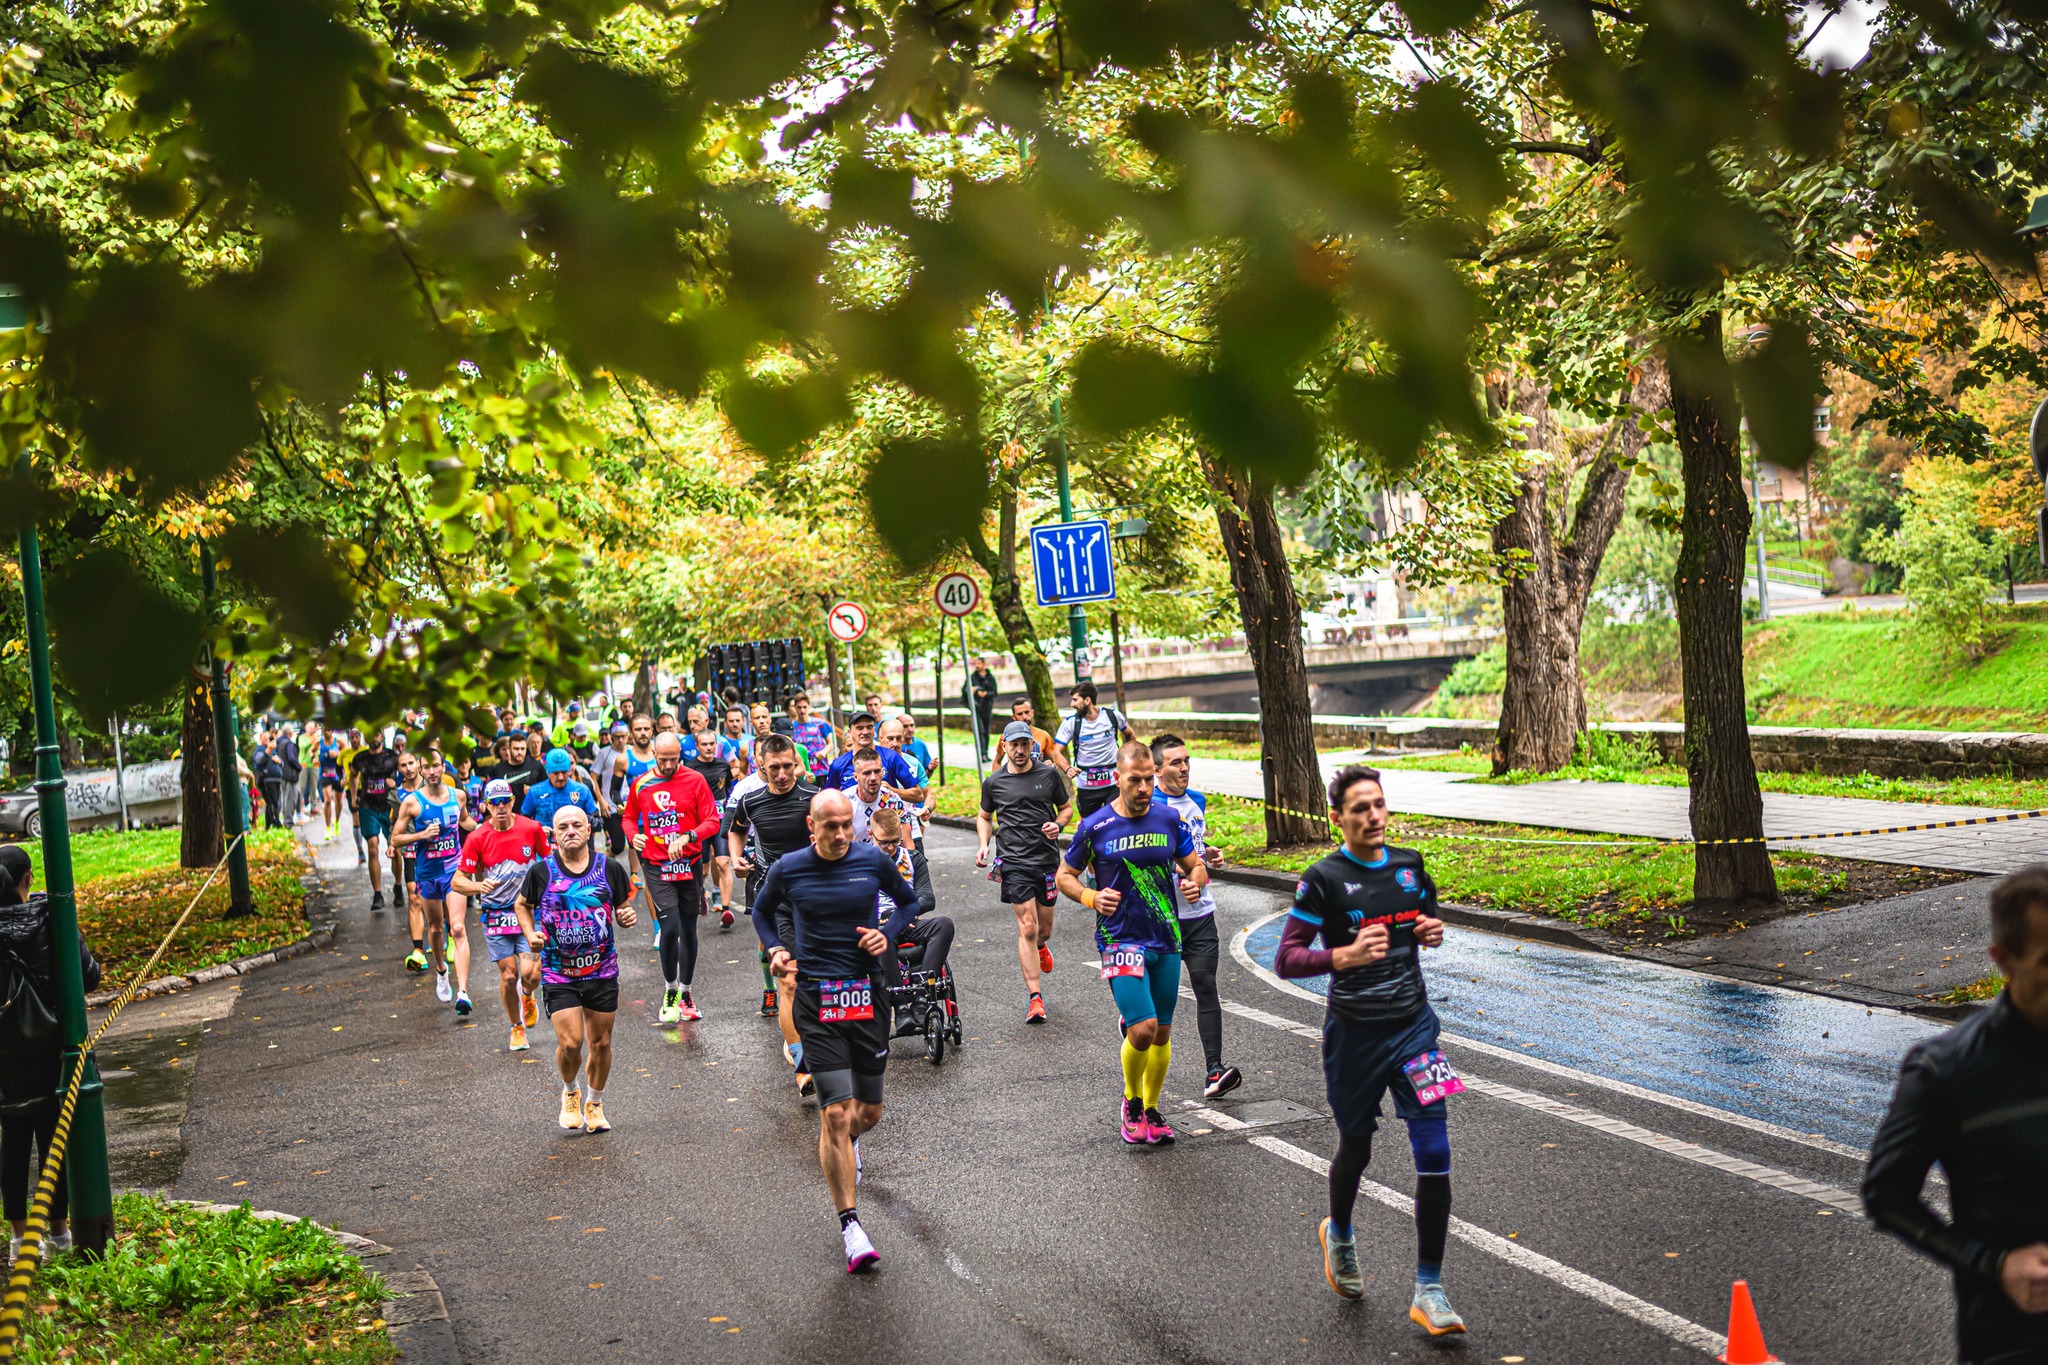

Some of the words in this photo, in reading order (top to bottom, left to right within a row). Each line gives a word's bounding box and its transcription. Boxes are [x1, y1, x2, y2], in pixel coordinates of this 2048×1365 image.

[944, 582, 970, 606] 40
[658, 815, 678, 828] 262
[438, 840, 455, 851] 203
[673, 863, 692, 874] 004
[500, 916, 518, 927] 218
[553, 909, 592, 922] STOP
[554, 920, 595, 929] VIOLENCE
[555, 927, 596, 936] AGAINST
[557, 935, 596, 944] WOMEN
[576, 953, 600, 968] 002
[1116, 952, 1143, 966] 009
[840, 990, 871, 1007] 008
